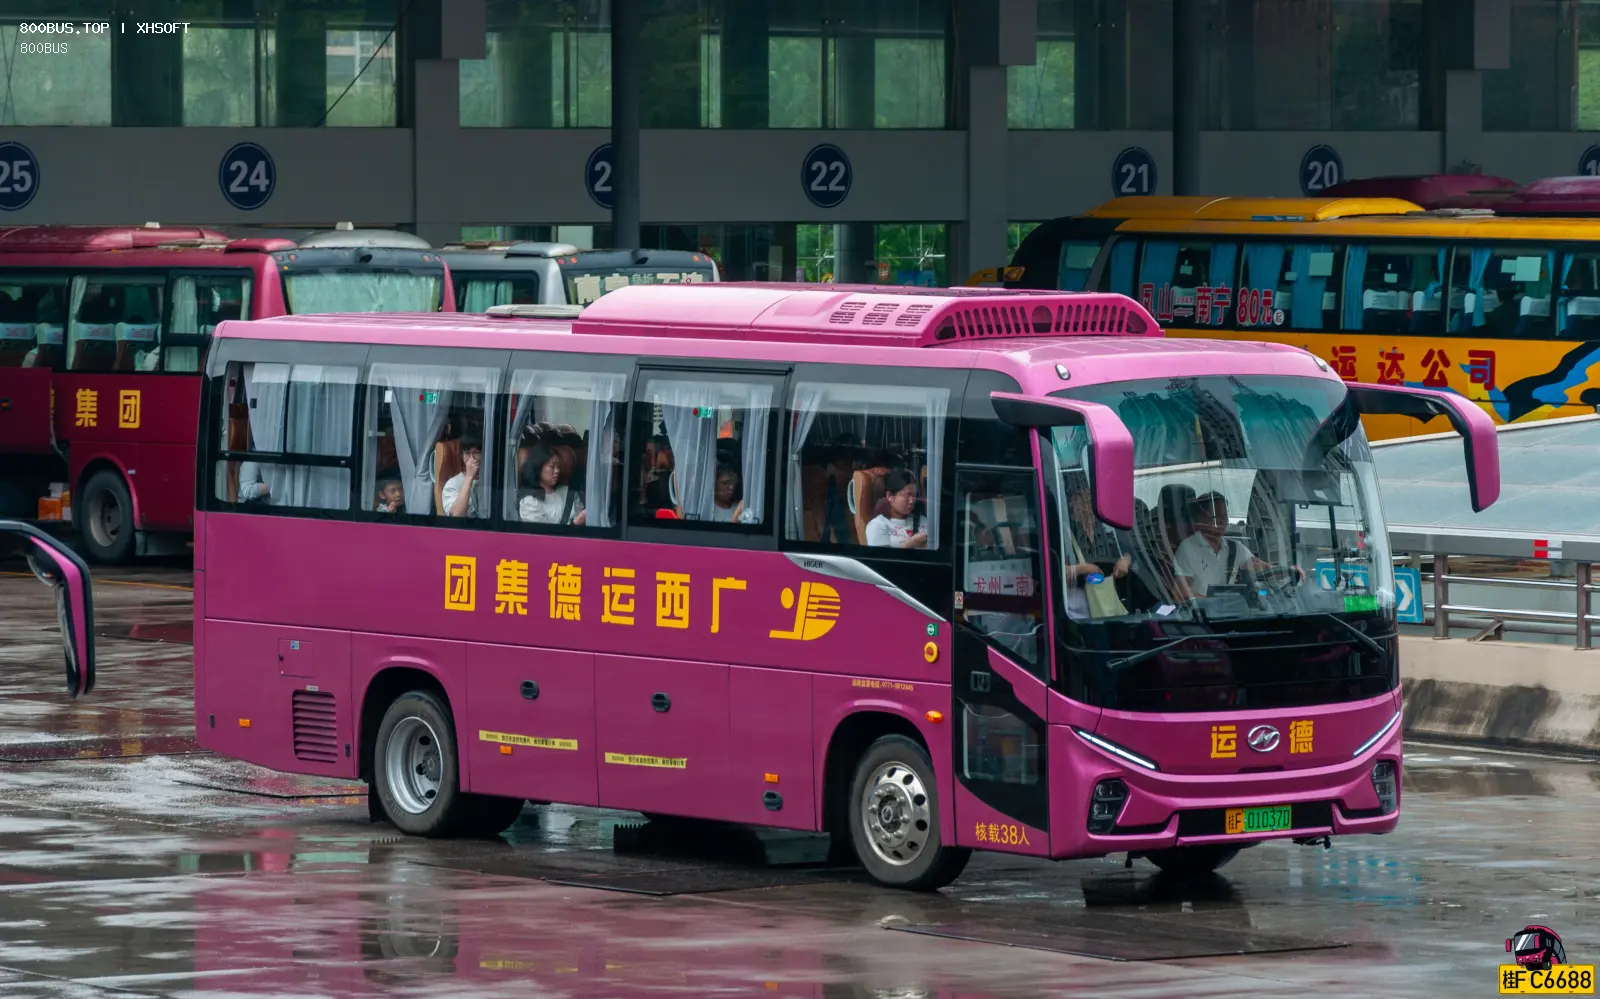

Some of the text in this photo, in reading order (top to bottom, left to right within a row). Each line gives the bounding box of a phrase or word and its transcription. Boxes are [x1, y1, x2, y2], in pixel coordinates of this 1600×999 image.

[229, 160, 269, 193] 24
[594, 160, 612, 192] 2
[811, 160, 846, 192] 22
[1120, 163, 1149, 193] 21
[1307, 160, 1339, 190] 20
[1331, 345, 1495, 390] 运达公司
[51, 388, 141, 428] 集团
[803, 560, 823, 569] HIGER
[975, 822, 1030, 846] 核载38人
